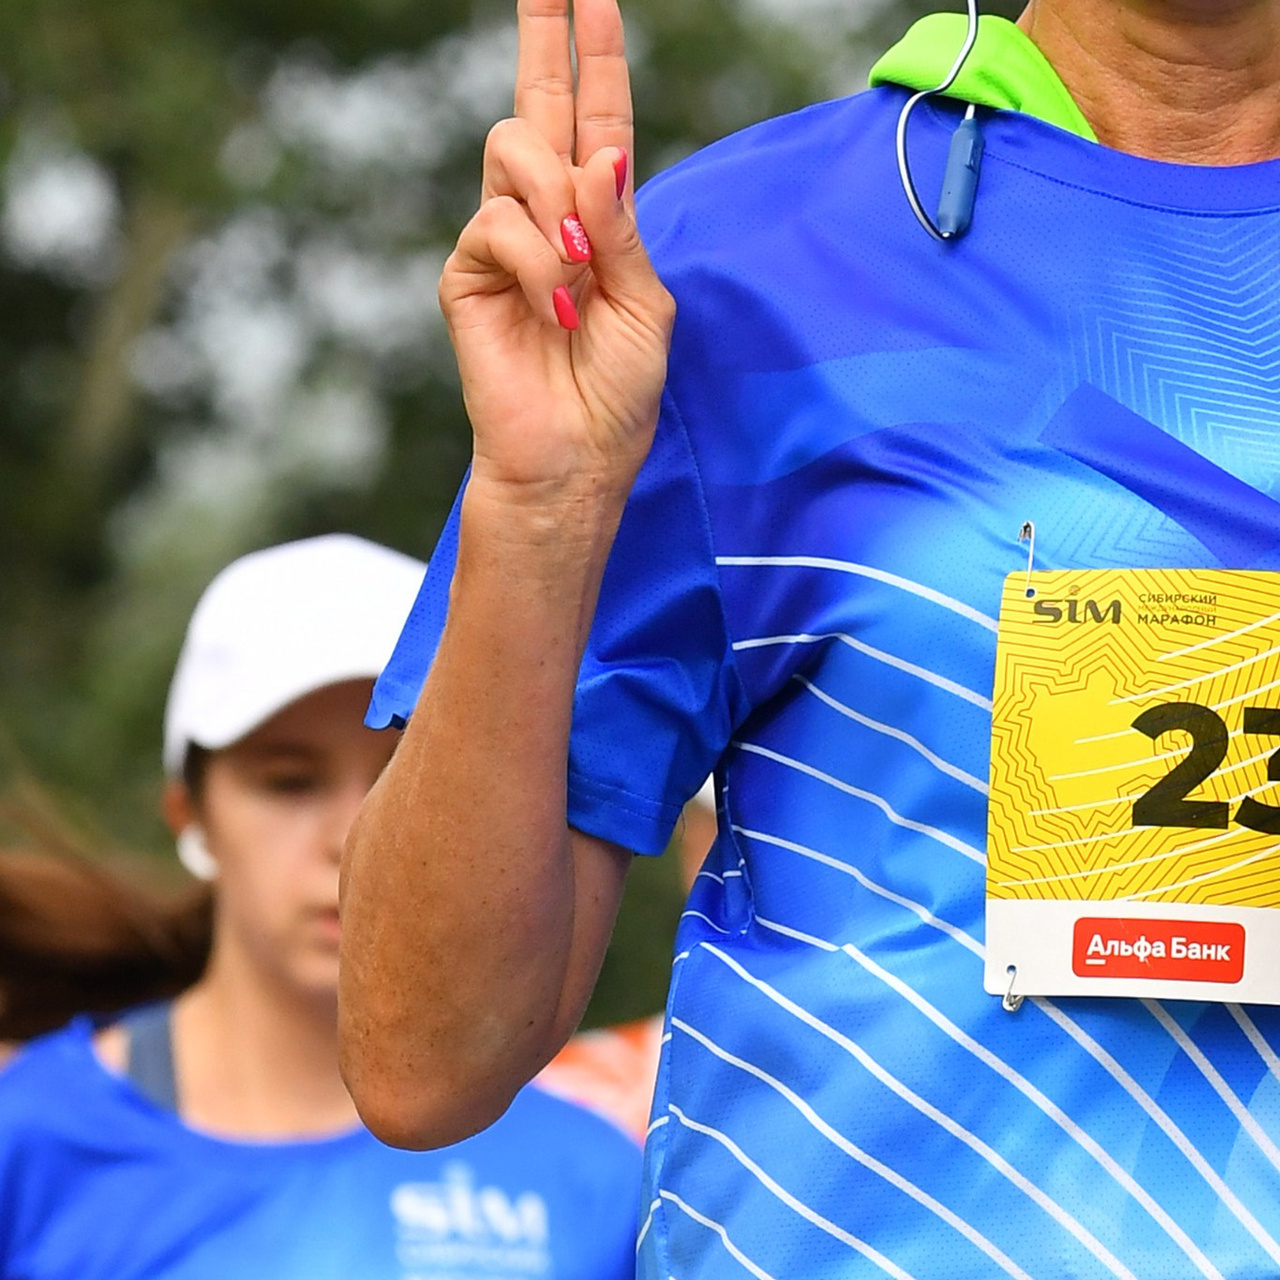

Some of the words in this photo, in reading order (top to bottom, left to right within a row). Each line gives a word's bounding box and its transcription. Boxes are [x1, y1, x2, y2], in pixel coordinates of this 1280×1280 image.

[1138, 593, 1217, 606] СИБИРСКИЙ
[1138, 614, 1216, 626] МАРАФОН
[1085, 934, 1166, 965] Альфа
[1171, 937, 1231, 961] Банк
